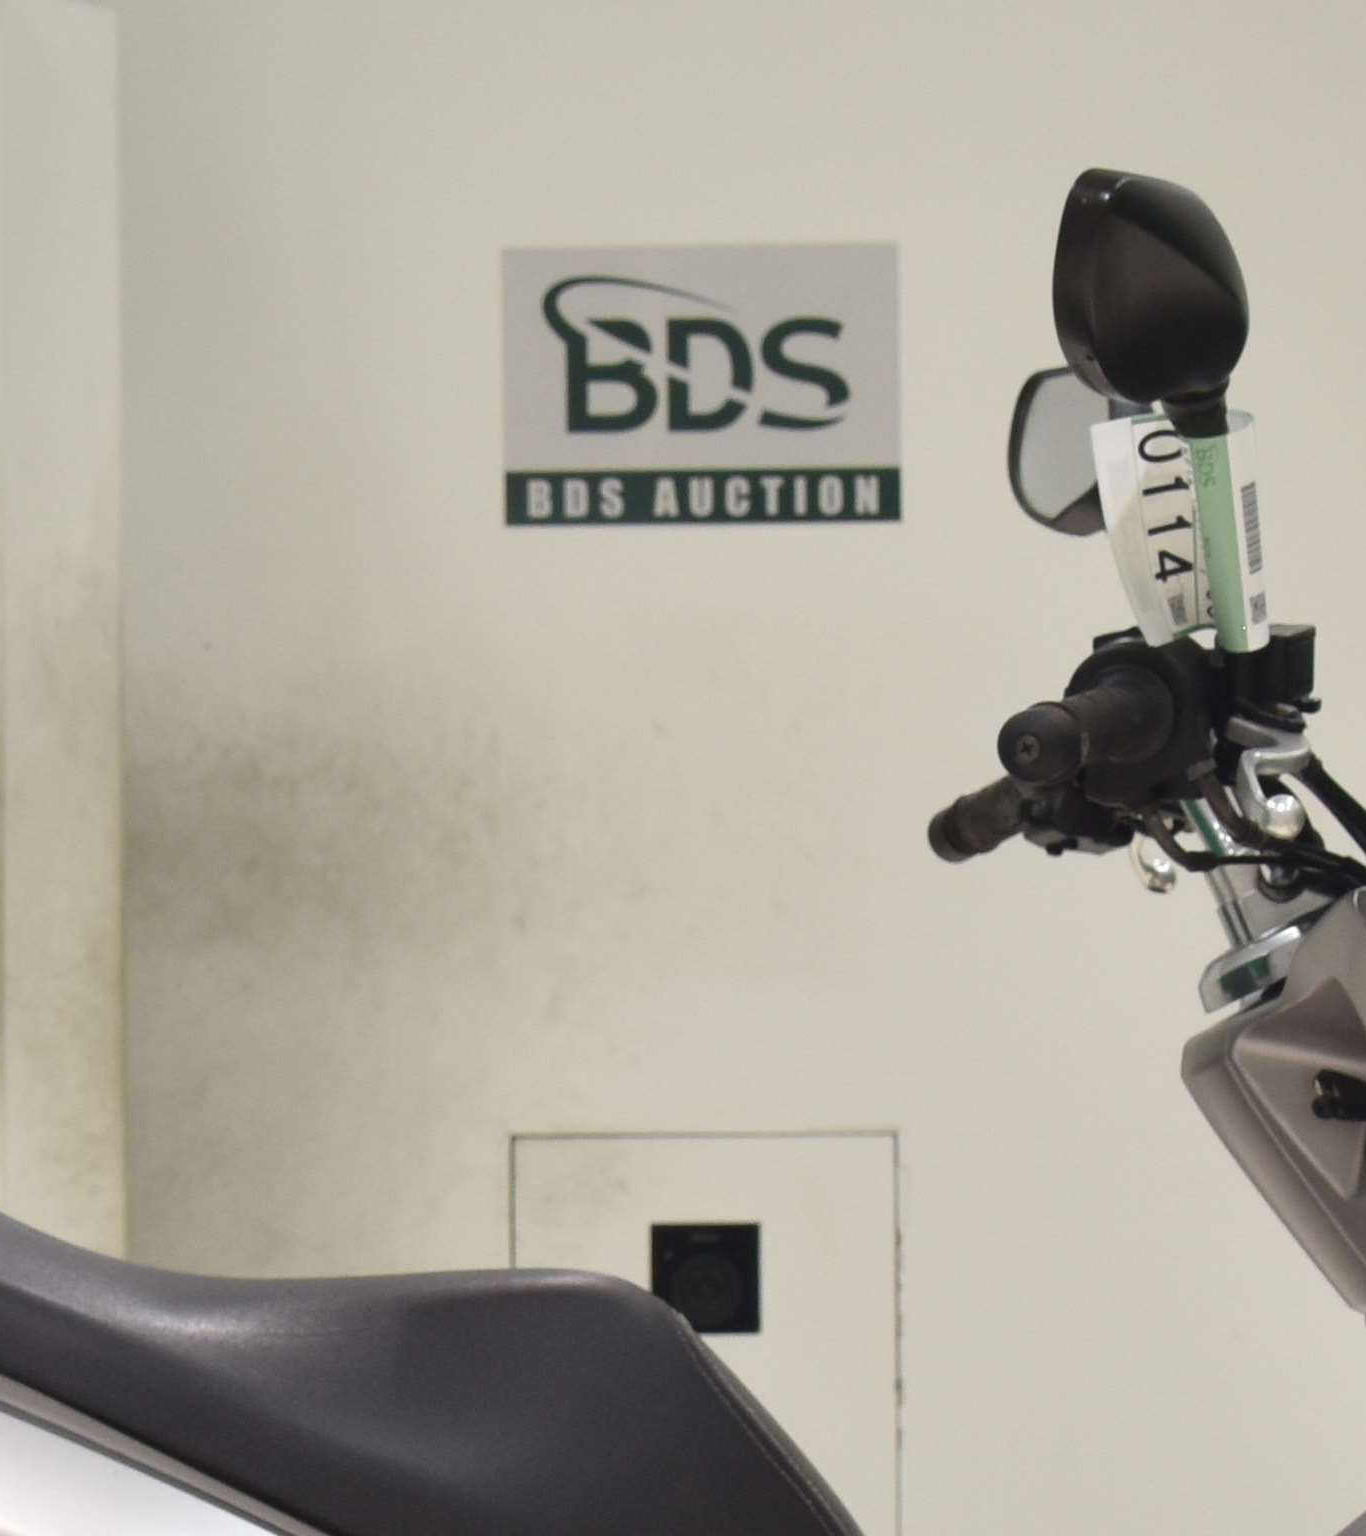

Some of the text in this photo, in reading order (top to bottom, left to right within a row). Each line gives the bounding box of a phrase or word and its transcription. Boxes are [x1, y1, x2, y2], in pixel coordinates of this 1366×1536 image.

[543, 276, 850, 433] BDS
[526, 473, 881, 519] BDS AUCTION
[1137, 428, 1193, 584] 0114
